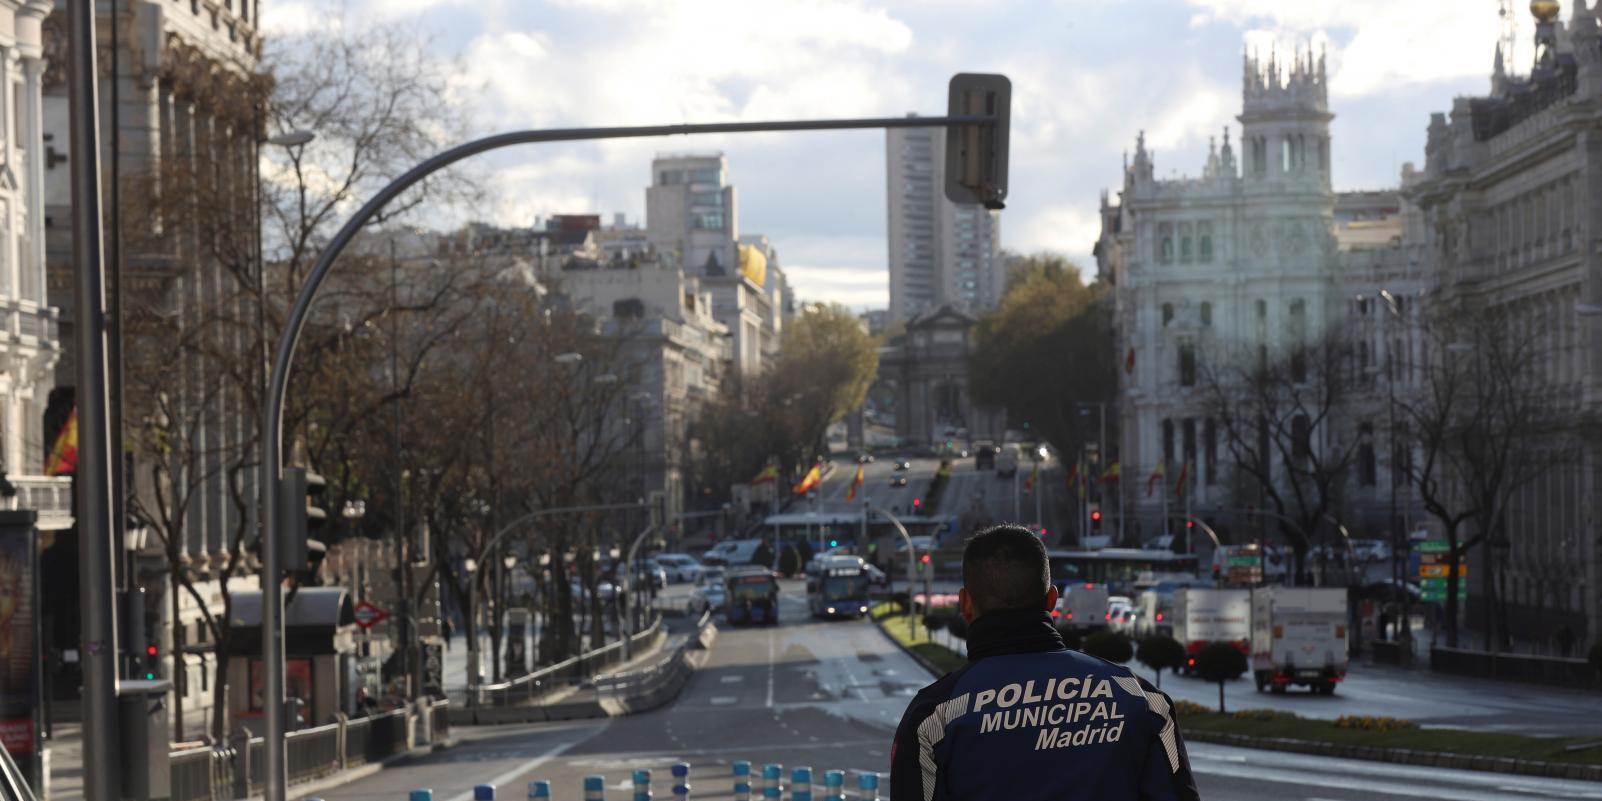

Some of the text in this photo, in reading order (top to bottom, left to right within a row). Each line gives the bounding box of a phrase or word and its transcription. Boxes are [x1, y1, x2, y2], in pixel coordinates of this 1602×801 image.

[973, 674, 1113, 712] POLICÍA
[980, 702, 1124, 733] MUNICIPAL
[1035, 721, 1124, 750] Madrid
